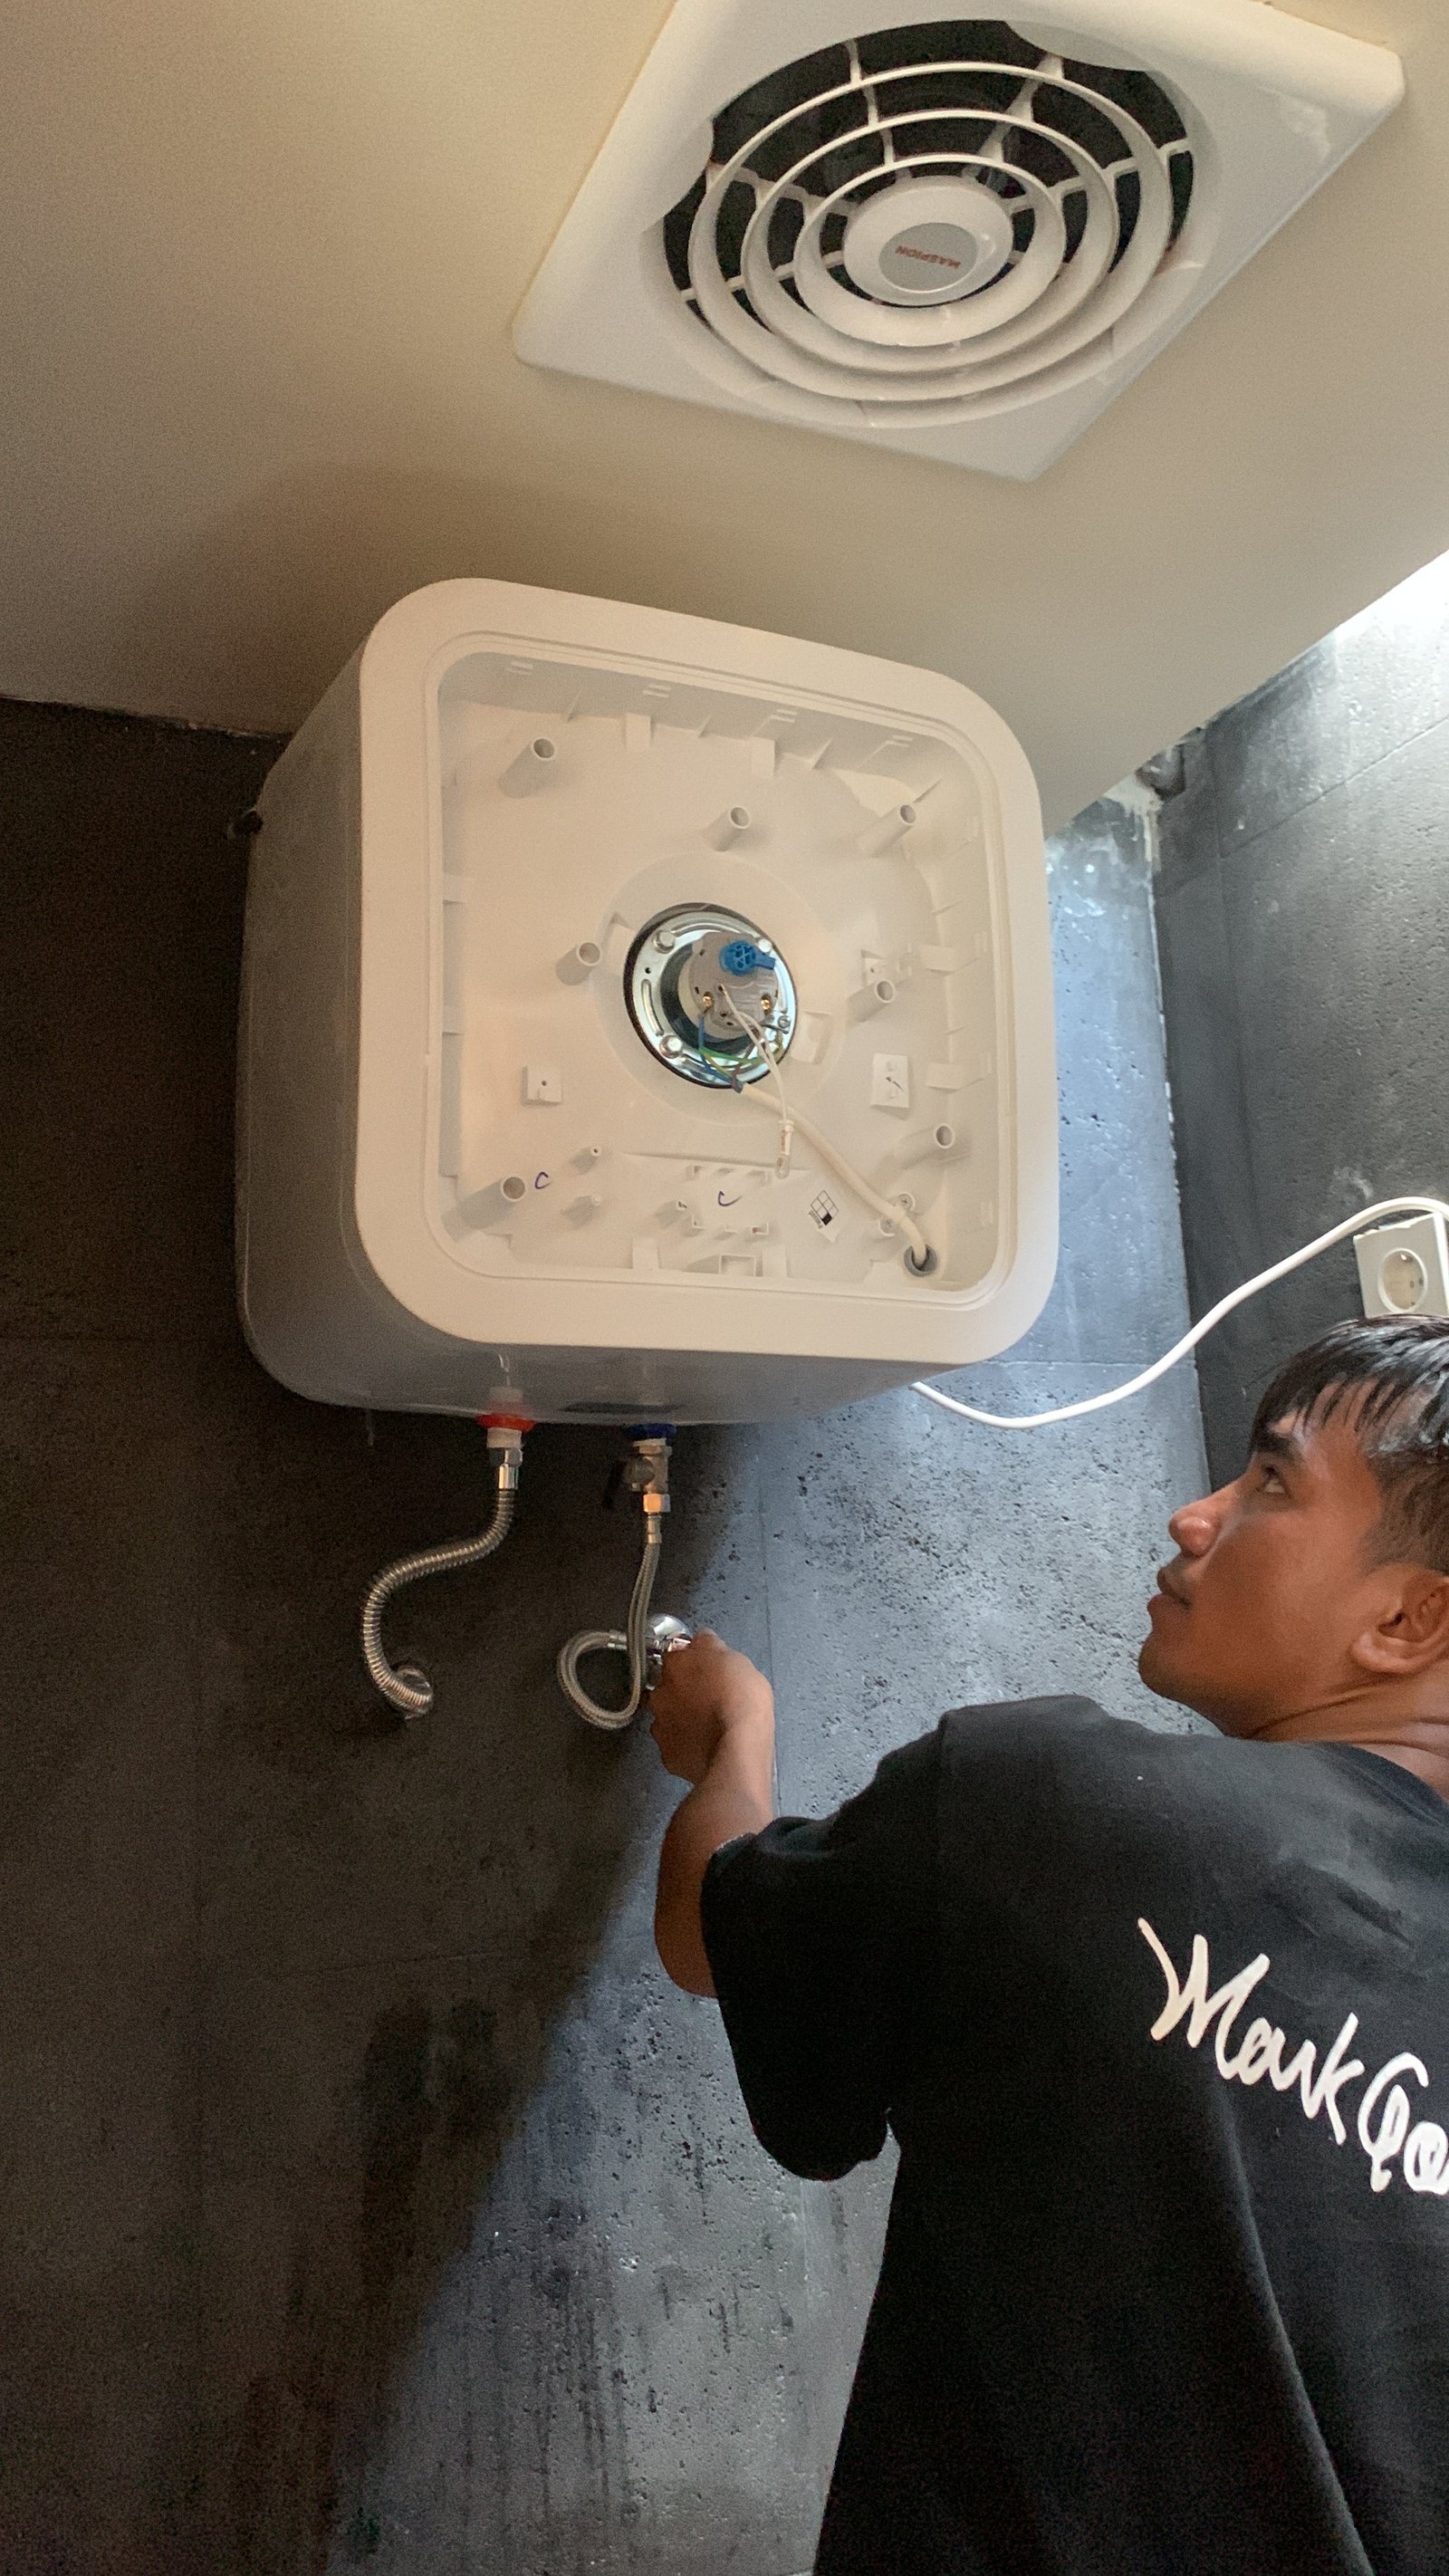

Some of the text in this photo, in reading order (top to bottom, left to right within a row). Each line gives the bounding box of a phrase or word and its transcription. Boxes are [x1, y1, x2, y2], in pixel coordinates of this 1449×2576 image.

[895, 245, 962, 269] MASPION
[1137, 1917, 1449, 2196] Mark Go
